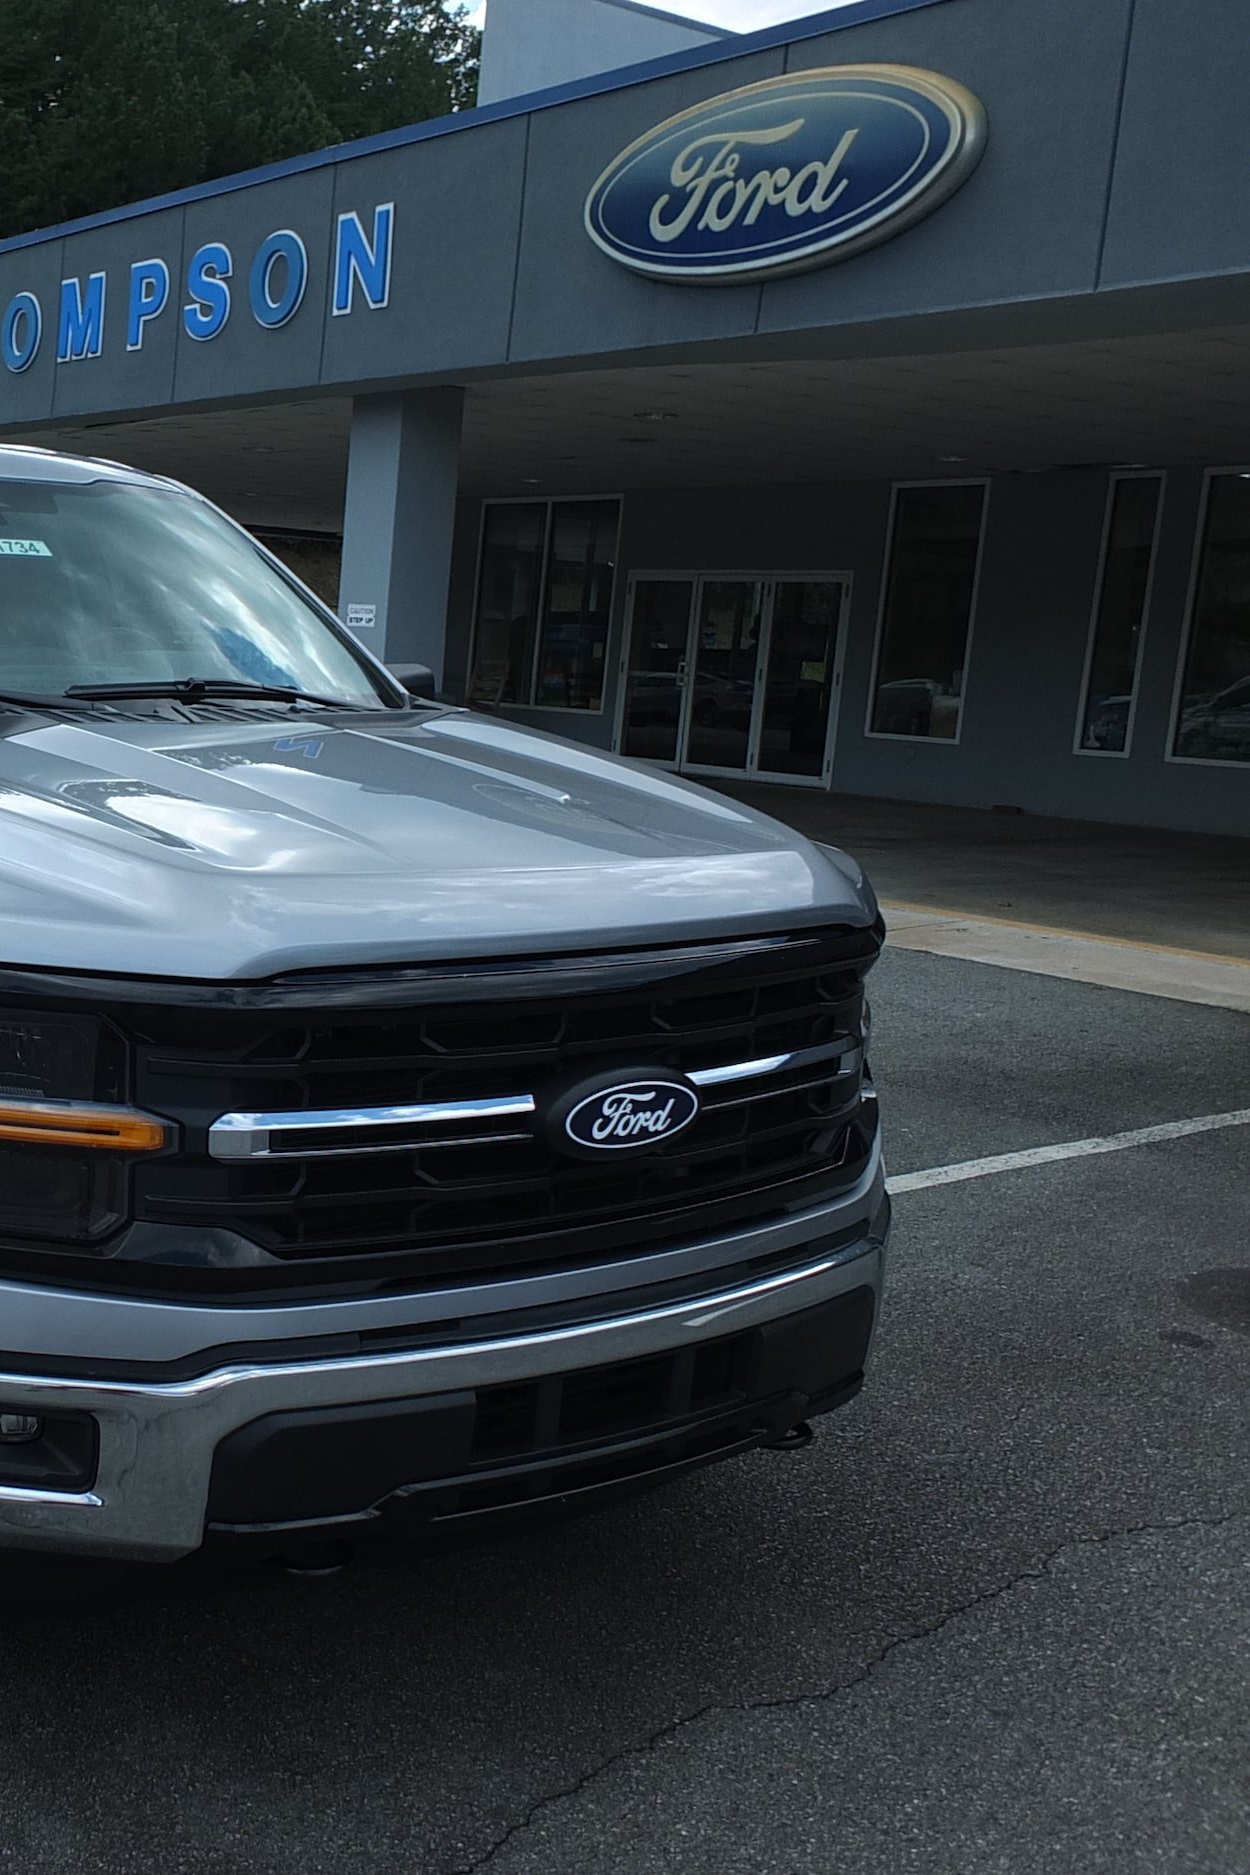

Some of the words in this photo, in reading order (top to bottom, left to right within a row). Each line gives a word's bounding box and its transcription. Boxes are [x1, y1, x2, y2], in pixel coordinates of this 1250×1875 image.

[649, 117, 860, 243] Ford
[364, 616, 374, 624] UP
[592, 1091, 675, 1140] Ford
